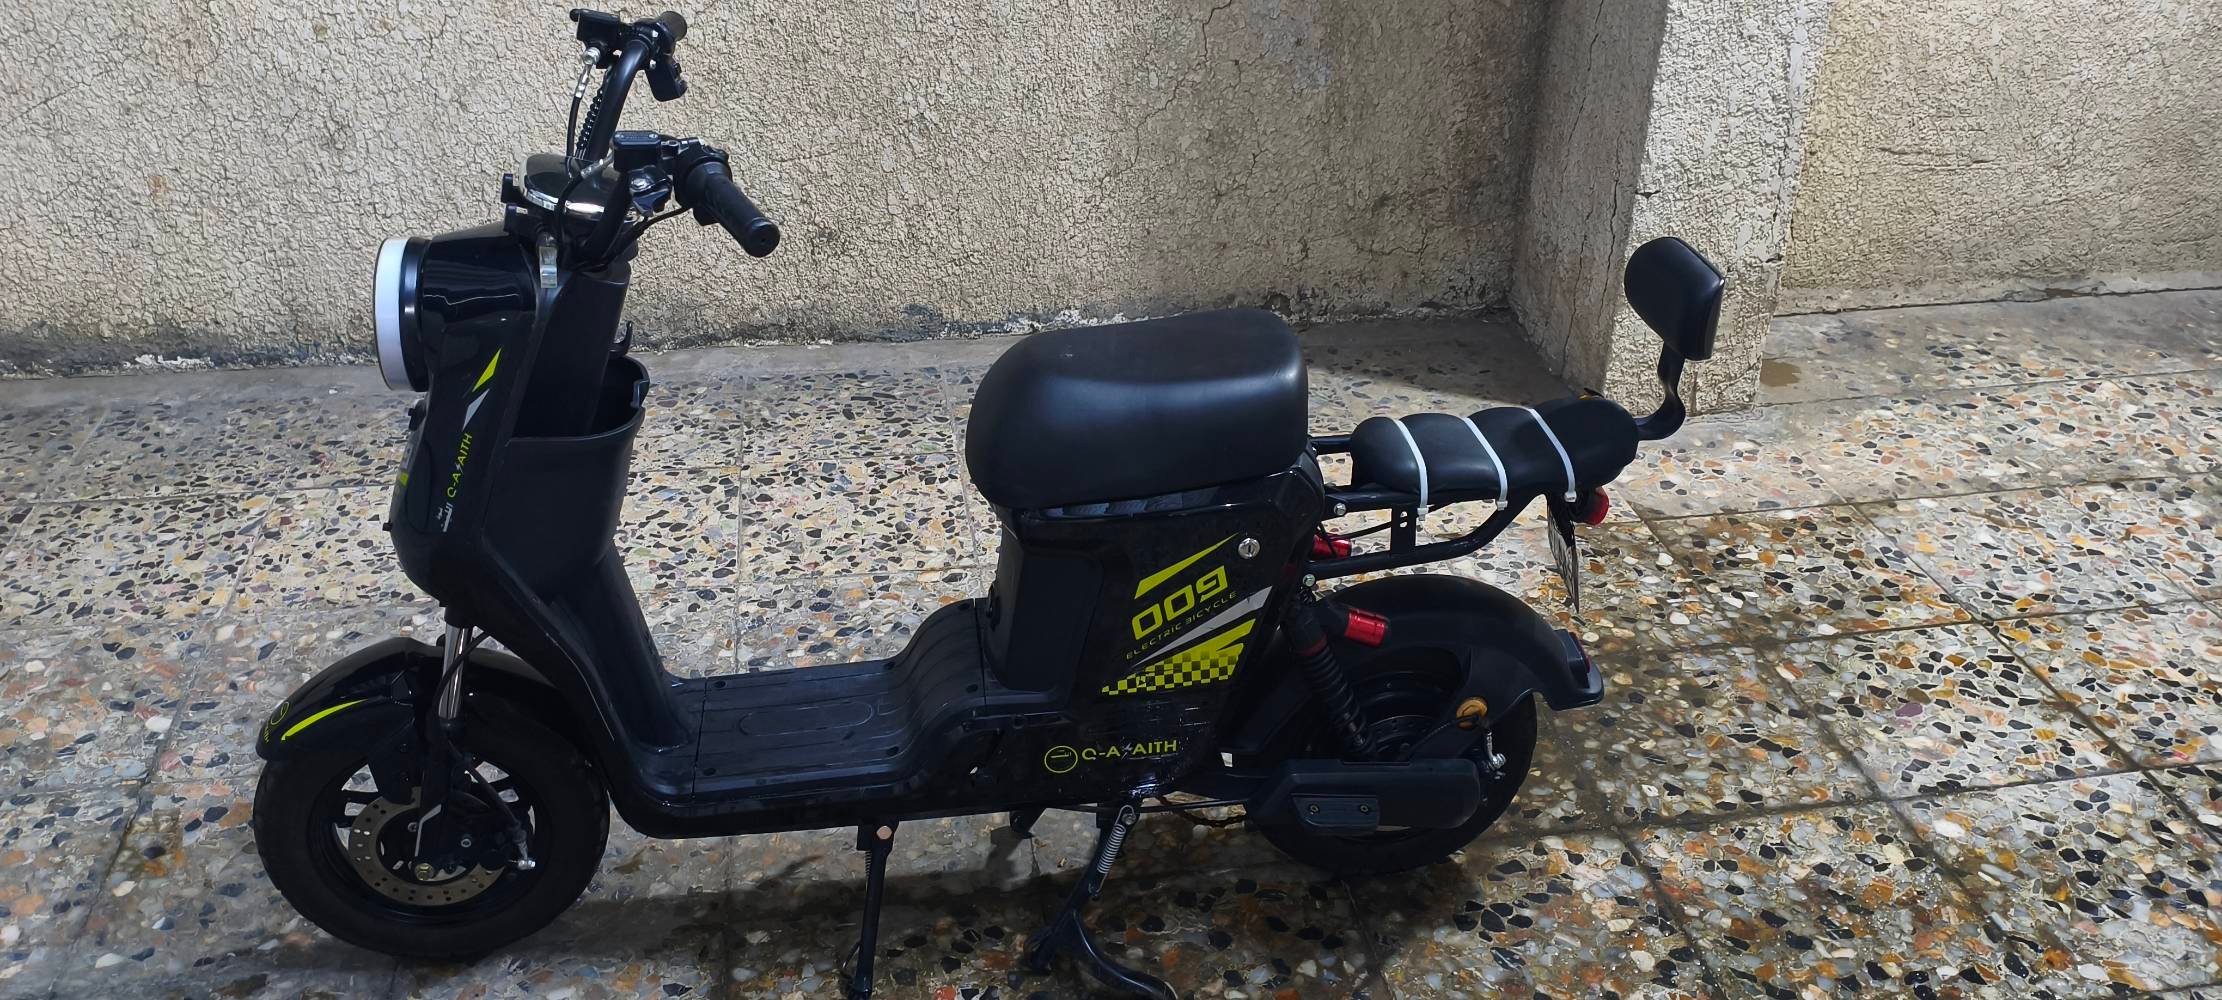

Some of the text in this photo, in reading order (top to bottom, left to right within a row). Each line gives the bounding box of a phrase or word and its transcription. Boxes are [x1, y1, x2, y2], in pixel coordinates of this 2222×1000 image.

[1125, 591, 1238, 661] ELECTRIC BICYCLE
[1131, 565, 1229, 641] 009
